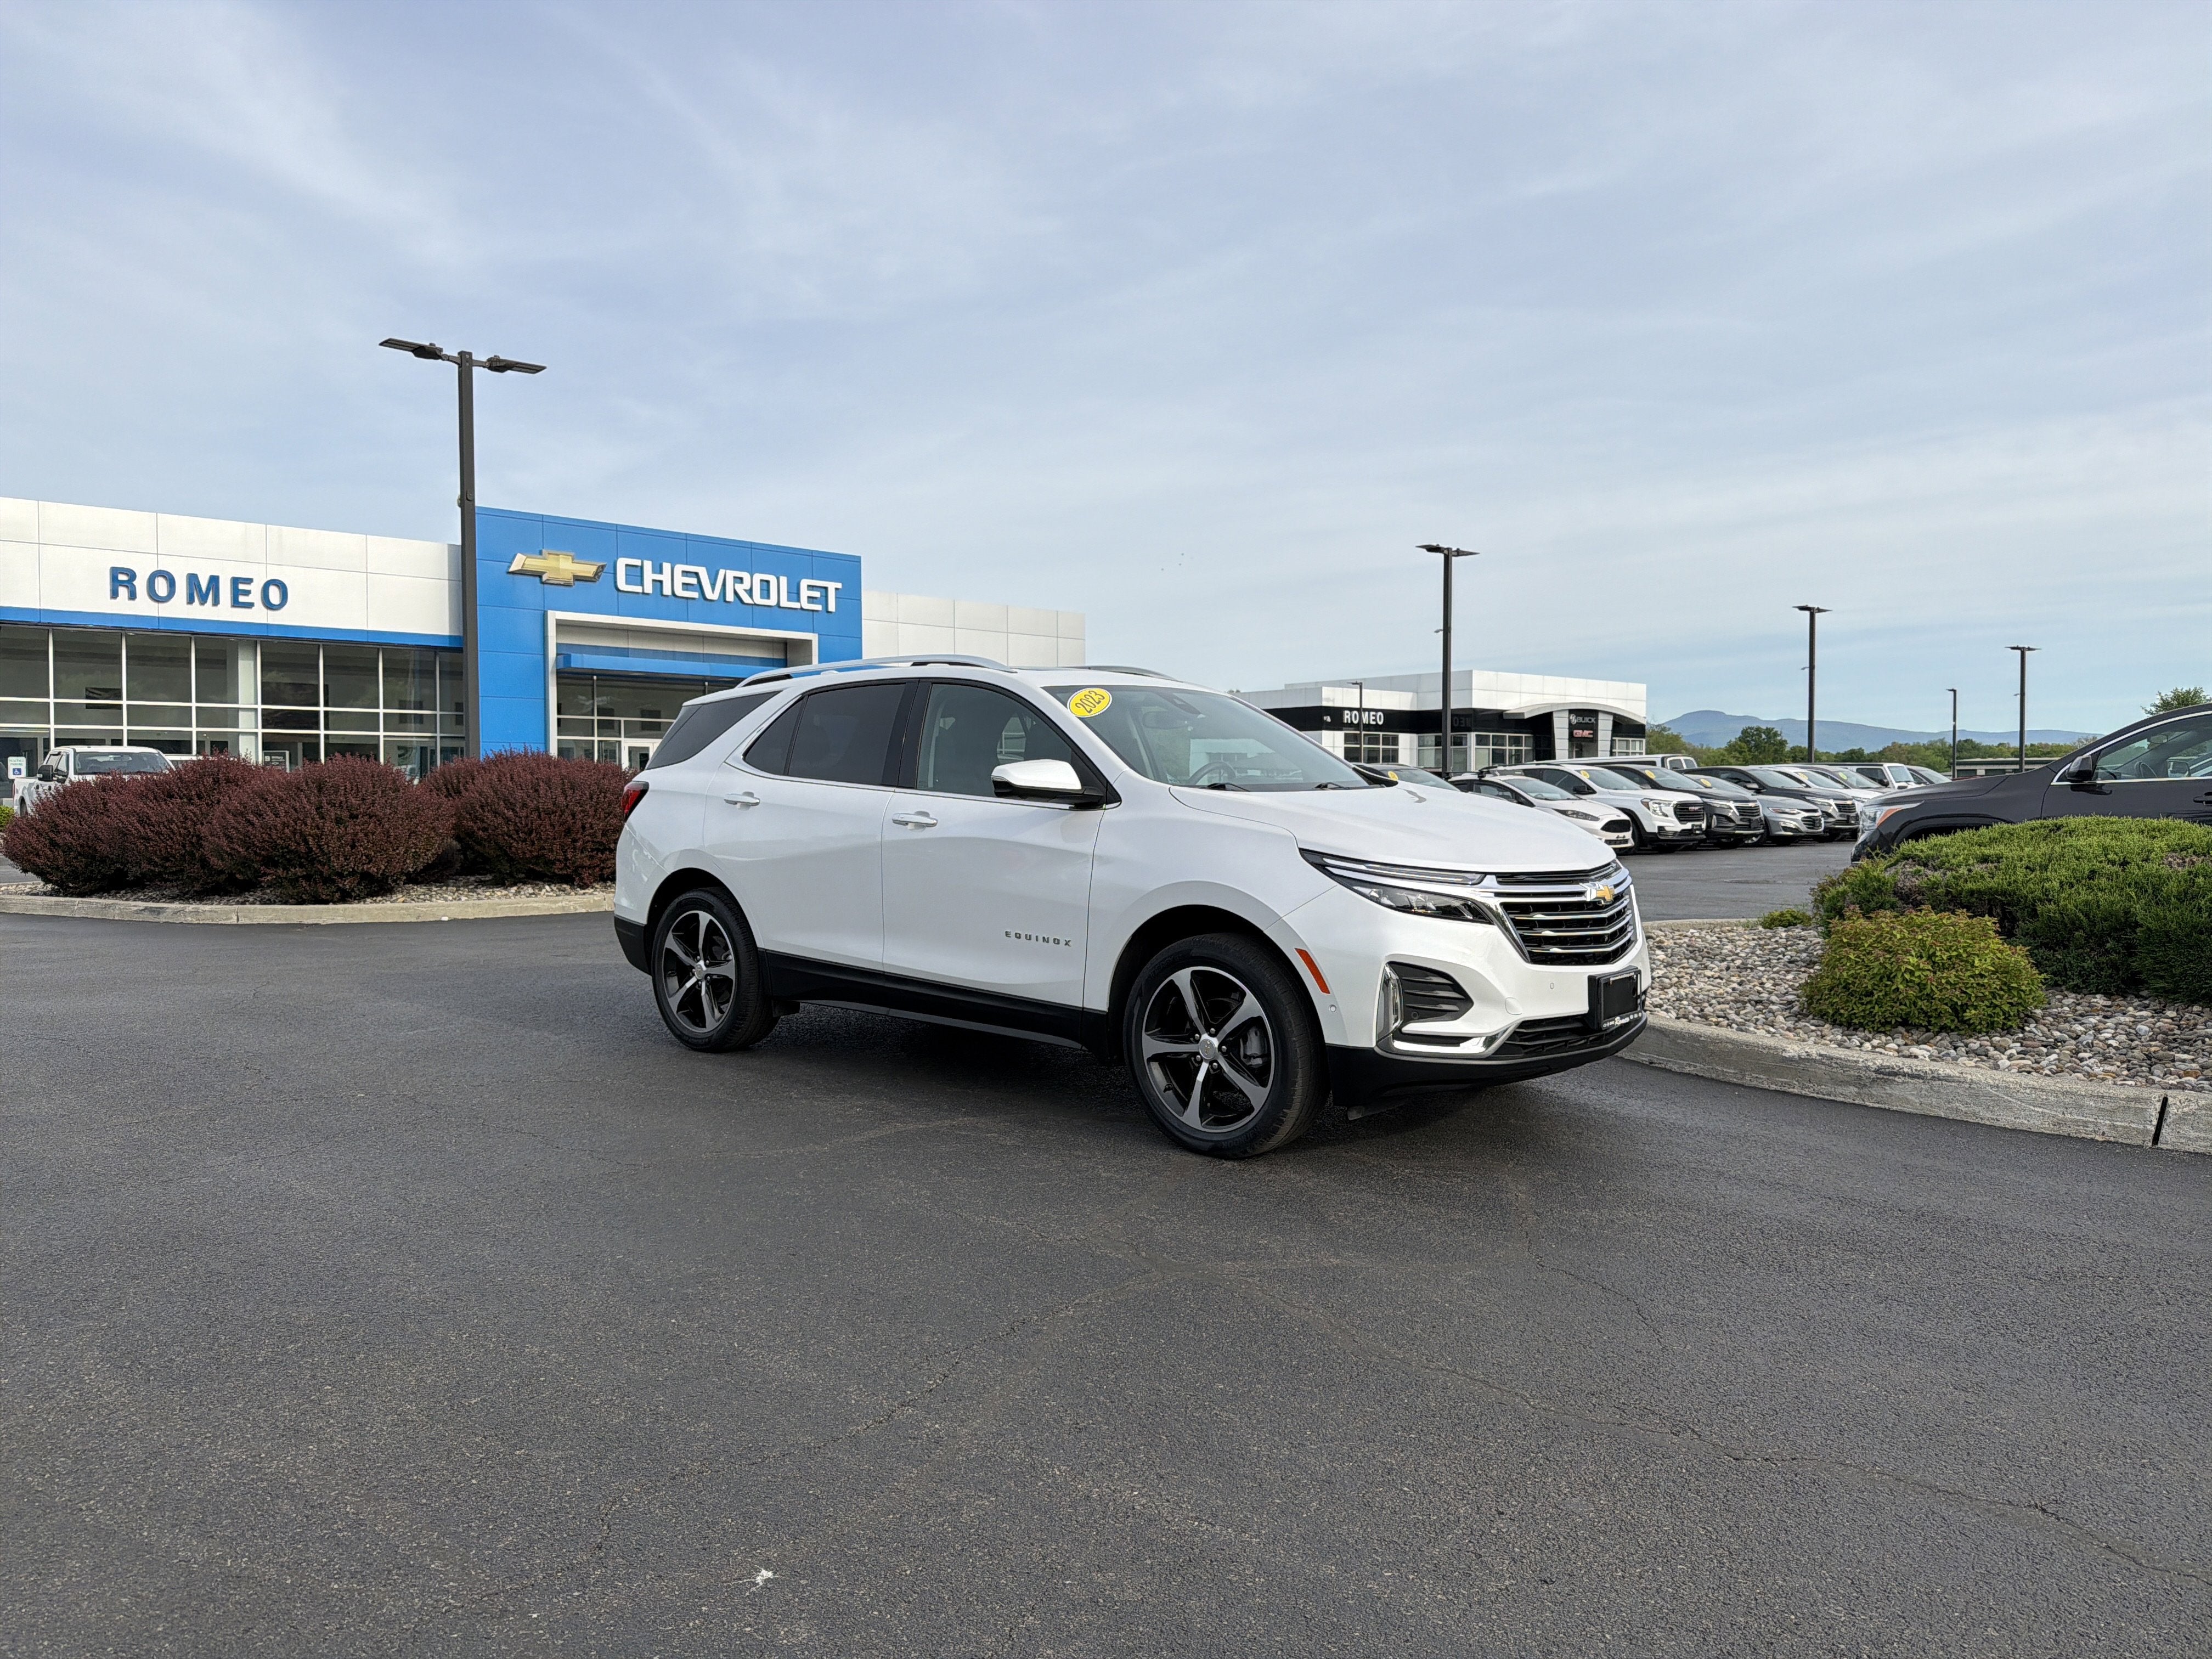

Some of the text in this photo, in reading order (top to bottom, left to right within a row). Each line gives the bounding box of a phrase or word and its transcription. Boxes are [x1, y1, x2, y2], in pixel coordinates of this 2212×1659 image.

[109, 566, 289, 611] ROMEO
[616, 557, 842, 613] CHEVROLET
[1075, 690, 1105, 714] 2023
[1343, 710, 1384, 725] ROMEO
[1573, 730, 1594, 738] GMC
[1005, 931, 1071, 947] EQUINOX
